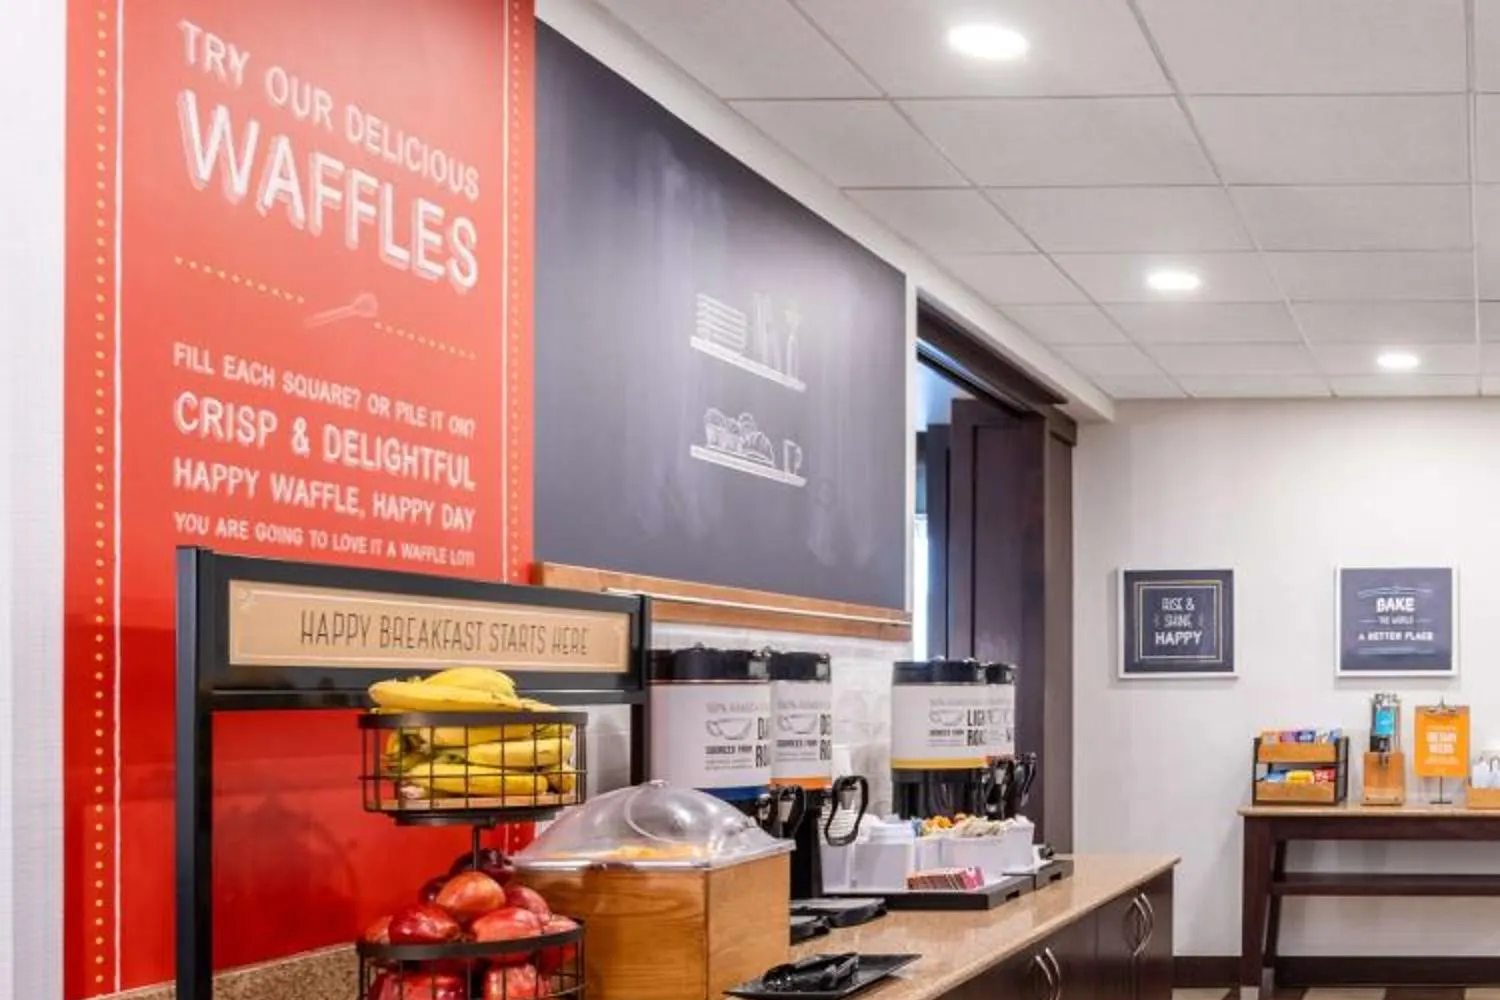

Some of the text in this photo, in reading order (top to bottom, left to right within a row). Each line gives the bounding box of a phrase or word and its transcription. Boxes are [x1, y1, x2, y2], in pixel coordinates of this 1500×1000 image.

[178, 17, 480, 201] TRY OUR DELICIOUS
[176, 88, 479, 294] WAFFLES
[173, 342, 215, 375] FILL
[222, 353, 276, 389] EACH
[282, 369, 361, 410] SQUARE?
[367, 392, 391, 418] OR
[395, 401, 428, 429] PILE
[430, 408, 445, 431] IT
[174, 390, 476, 492] CRISP & DELIGHTFUL
[173, 456, 477, 533] HAPPY WAFFLE, HAPPY DAY
[174, 511, 211, 537] YOU
[215, 517, 250, 541] ARE
[255, 521, 304, 547] GOING
[309, 529, 328, 549] TO
[332, 533, 368, 555] LOVE
[370, 537, 383, 556] IT
[386, 541, 397, 557] A
[401, 543, 447, 566] WAFFLE
[1186, 597, 1196, 612] &
[1376, 596, 1416, 613] BAKE
[301, 609, 590, 657] HAPPY BREAKFAST STARTS HERE
[1154, 630, 1203, 646] HAPPY
[1366, 630, 1403, 642] BETTER
